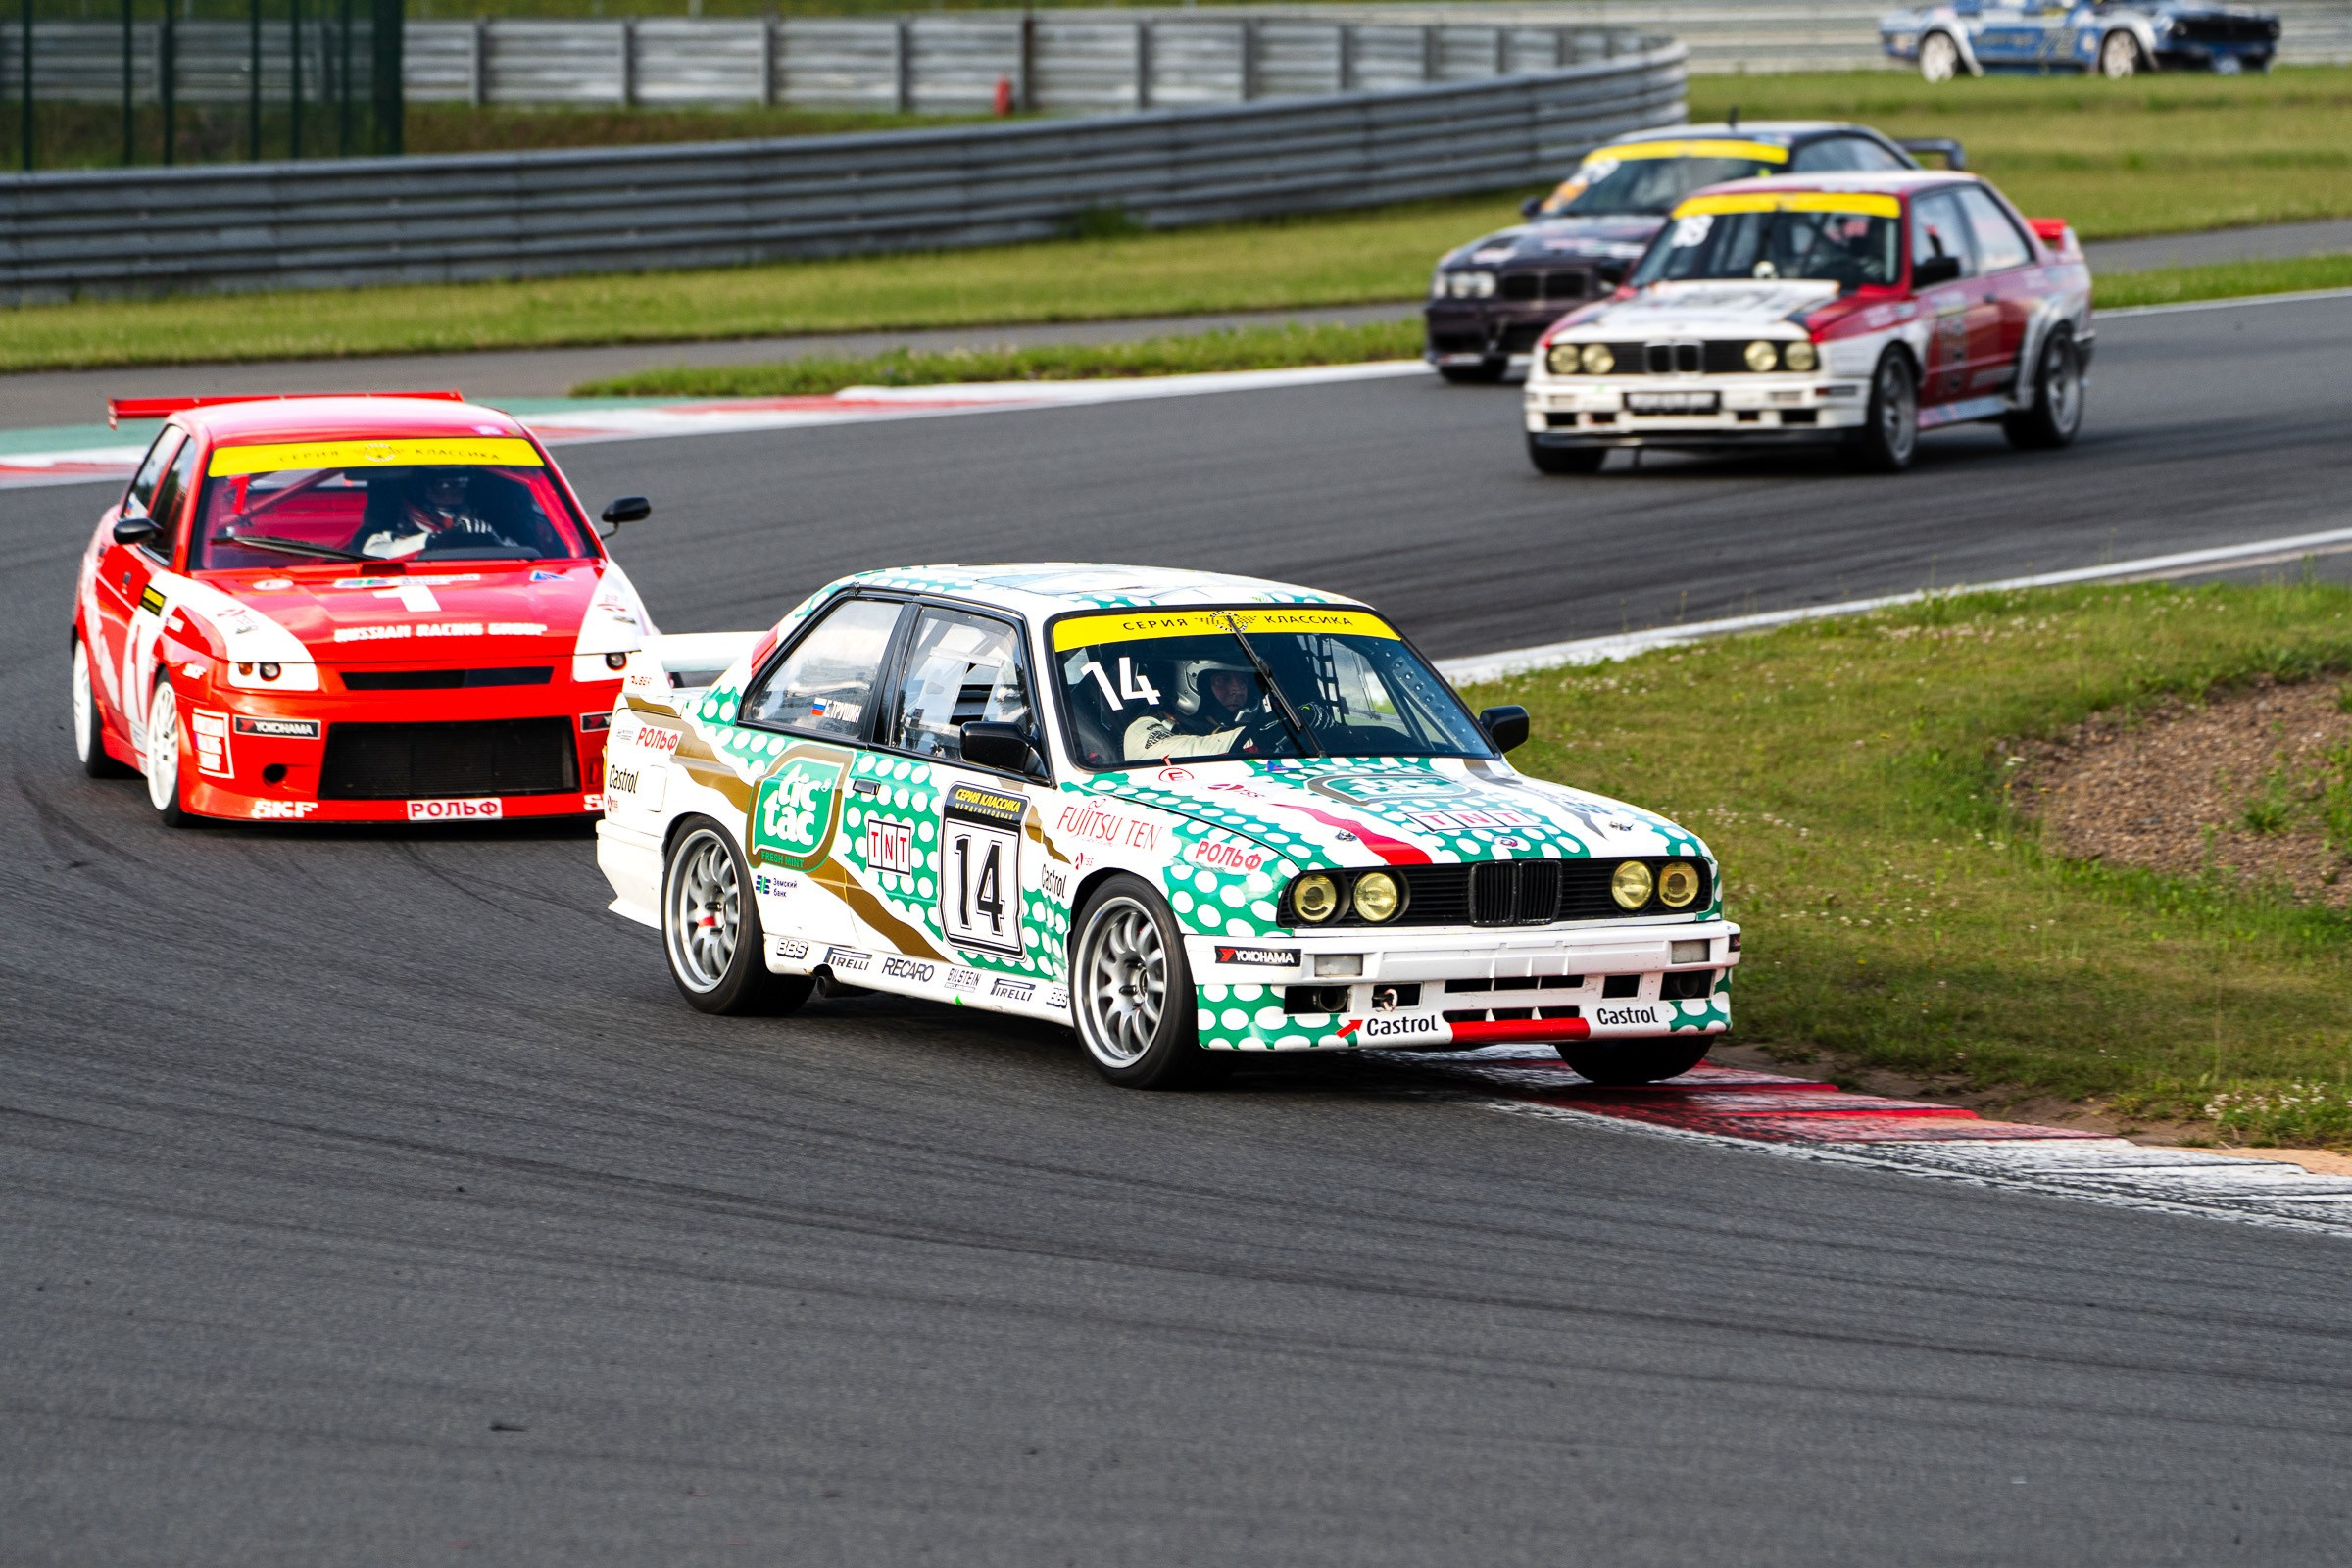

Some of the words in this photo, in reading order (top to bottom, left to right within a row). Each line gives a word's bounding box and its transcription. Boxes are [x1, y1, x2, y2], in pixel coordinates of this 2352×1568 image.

[278, 450, 340, 463] СЕРИЯ
[415, 447, 501, 461] КЛАССИКА
[1123, 617, 1189, 632] СЕРИЯ
[1264, 614, 1354, 627] КЛАССИКА
[1080, 656, 1162, 711] 14
[254, 721, 314, 736] YOKOHAMA
[635, 726, 679, 751] РОЛЬФ
[609, 764, 640, 794] Castrol
[777, 763, 821, 812] tic
[250, 800, 318, 819] SKF
[410, 800, 499, 818] РОЛЬФ
[955, 788, 981, 806] СЕРИЯ
[979, 793, 1022, 813] КЛАССИКА
[955, 802, 1014, 820] МЕЖДУНАРОДНАЯ
[763, 790, 815, 846] tac
[1057, 802, 1123, 842] FUJITSU
[1125, 819, 1163, 852] TEN
[1420, 812, 1525, 826] TNT
[870, 831, 908, 863] TNT
[1195, 840, 1263, 871] РОЛЬФ
[760, 850, 785, 865] FRESH
[785, 856, 806, 869] MINT
[772, 877, 798, 890] Земский
[955, 833, 1006, 936] 14
[1041, 863, 1068, 899] Castrol
[772, 888, 787, 898] банк
[776, 938, 809, 959] BBS
[823, 946, 873, 971] PIRELLI
[1235, 949, 1295, 964] YOKOHAMA
[881, 956, 935, 983] RECARO
[947, 967, 982, 987] BILSTEIN
[990, 977, 1037, 1002] PIRELLI
[1366, 1014, 1439, 1037] Castrol
[1596, 1005, 1659, 1025] Castrol
